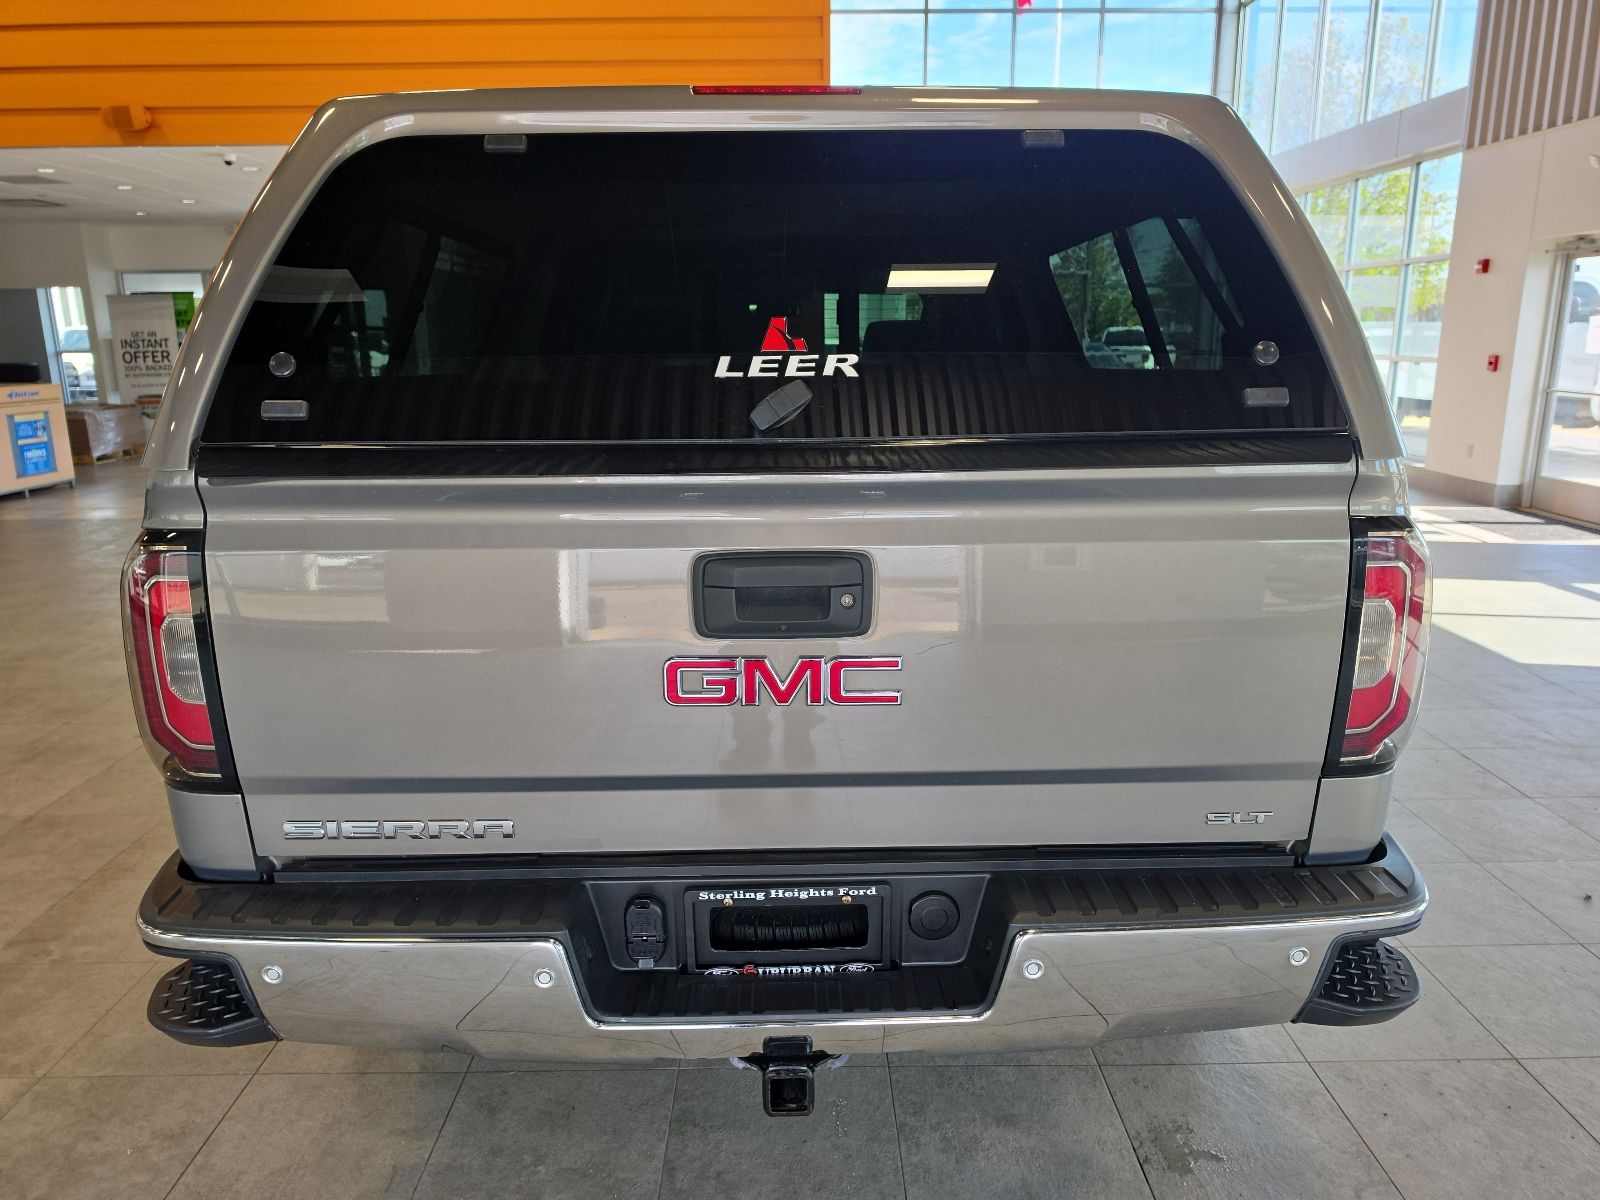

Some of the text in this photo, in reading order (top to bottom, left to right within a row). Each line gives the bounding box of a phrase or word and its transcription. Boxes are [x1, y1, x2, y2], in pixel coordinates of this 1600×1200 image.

[120, 338, 170, 349] INSTANT
[121, 350, 171, 365] OFFER
[714, 353, 860, 378] LEER
[663, 655, 903, 706] GMC
[1206, 811, 1274, 825] SLT
[283, 819, 516, 840] SIERRA
[698, 886, 877, 900] Sterling Heights Ford
